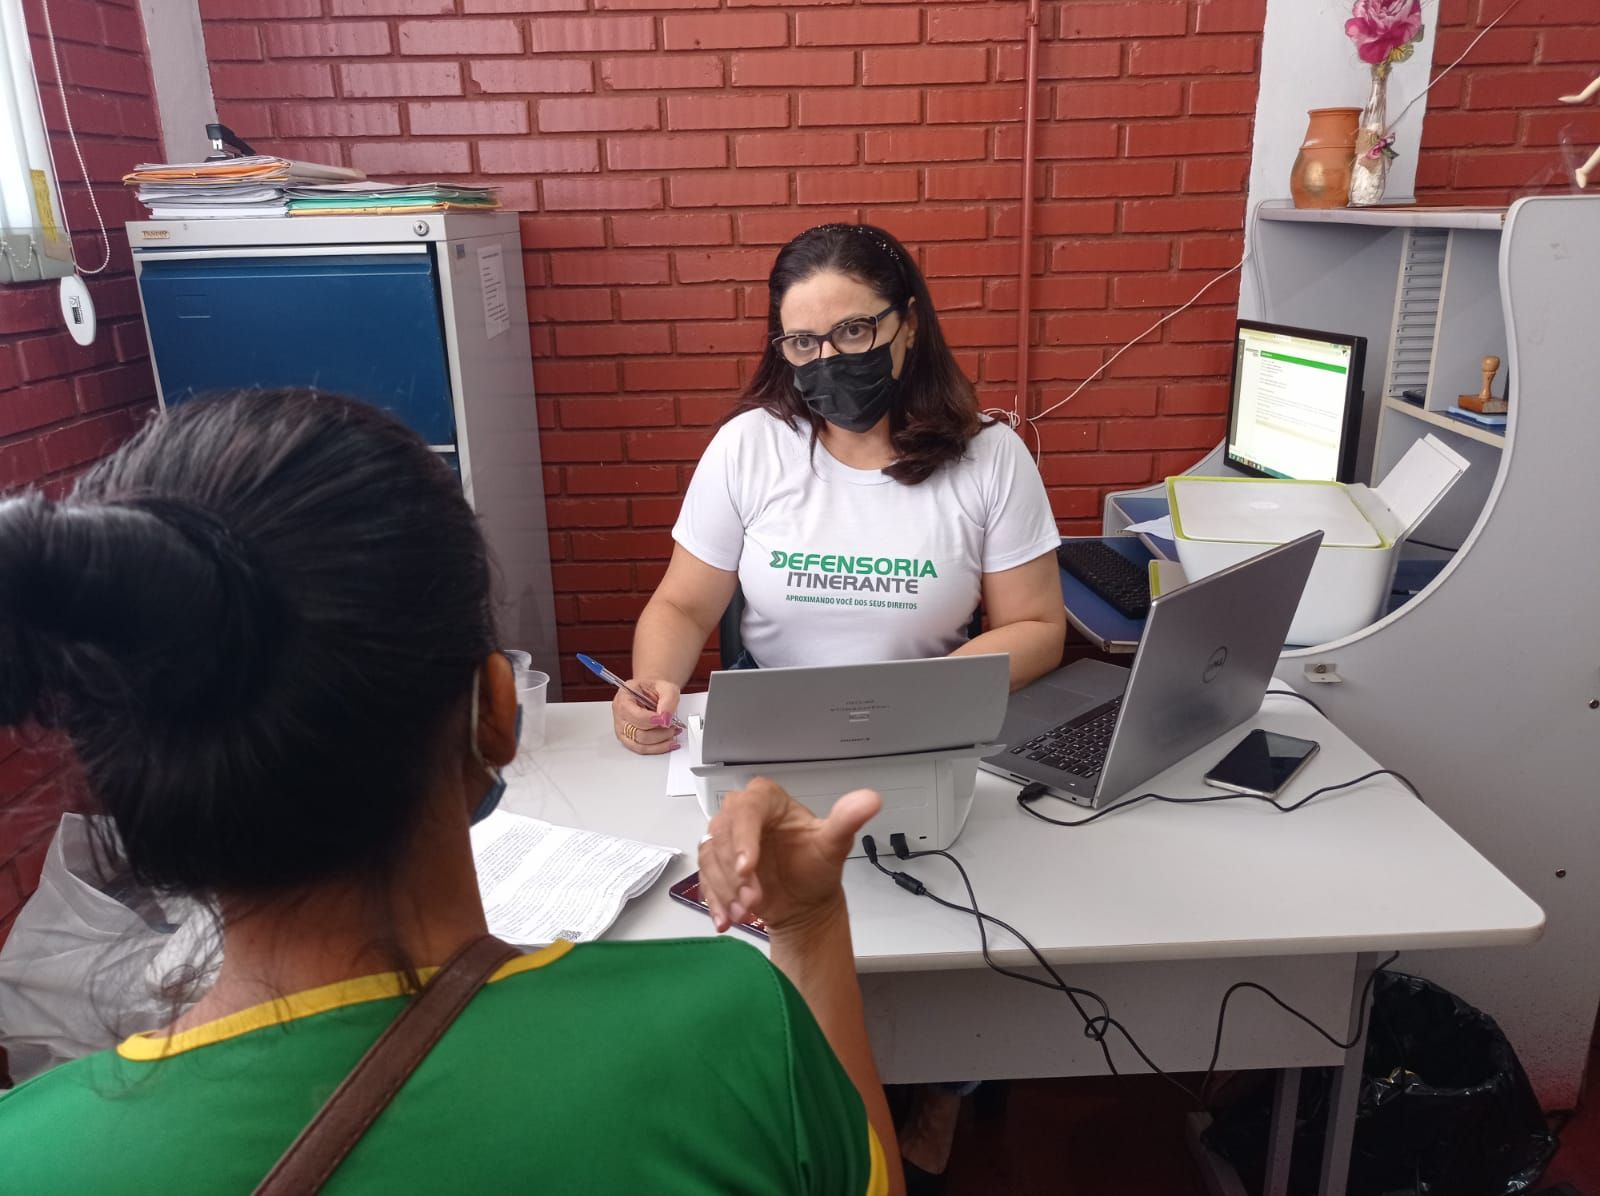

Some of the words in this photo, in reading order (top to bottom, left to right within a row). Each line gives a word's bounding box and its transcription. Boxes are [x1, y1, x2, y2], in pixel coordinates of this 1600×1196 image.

[769, 550, 938, 578] DEFENSORIA
[786, 571, 919, 594] ITINERANTE
[785, 594, 835, 604] APROXIMANDO
[836, 597, 853, 606] VOCÊ
[854, 599, 868, 607] DOS
[869, 600, 886, 608] SEUS
[887, 601, 918, 610] DIREITOS
